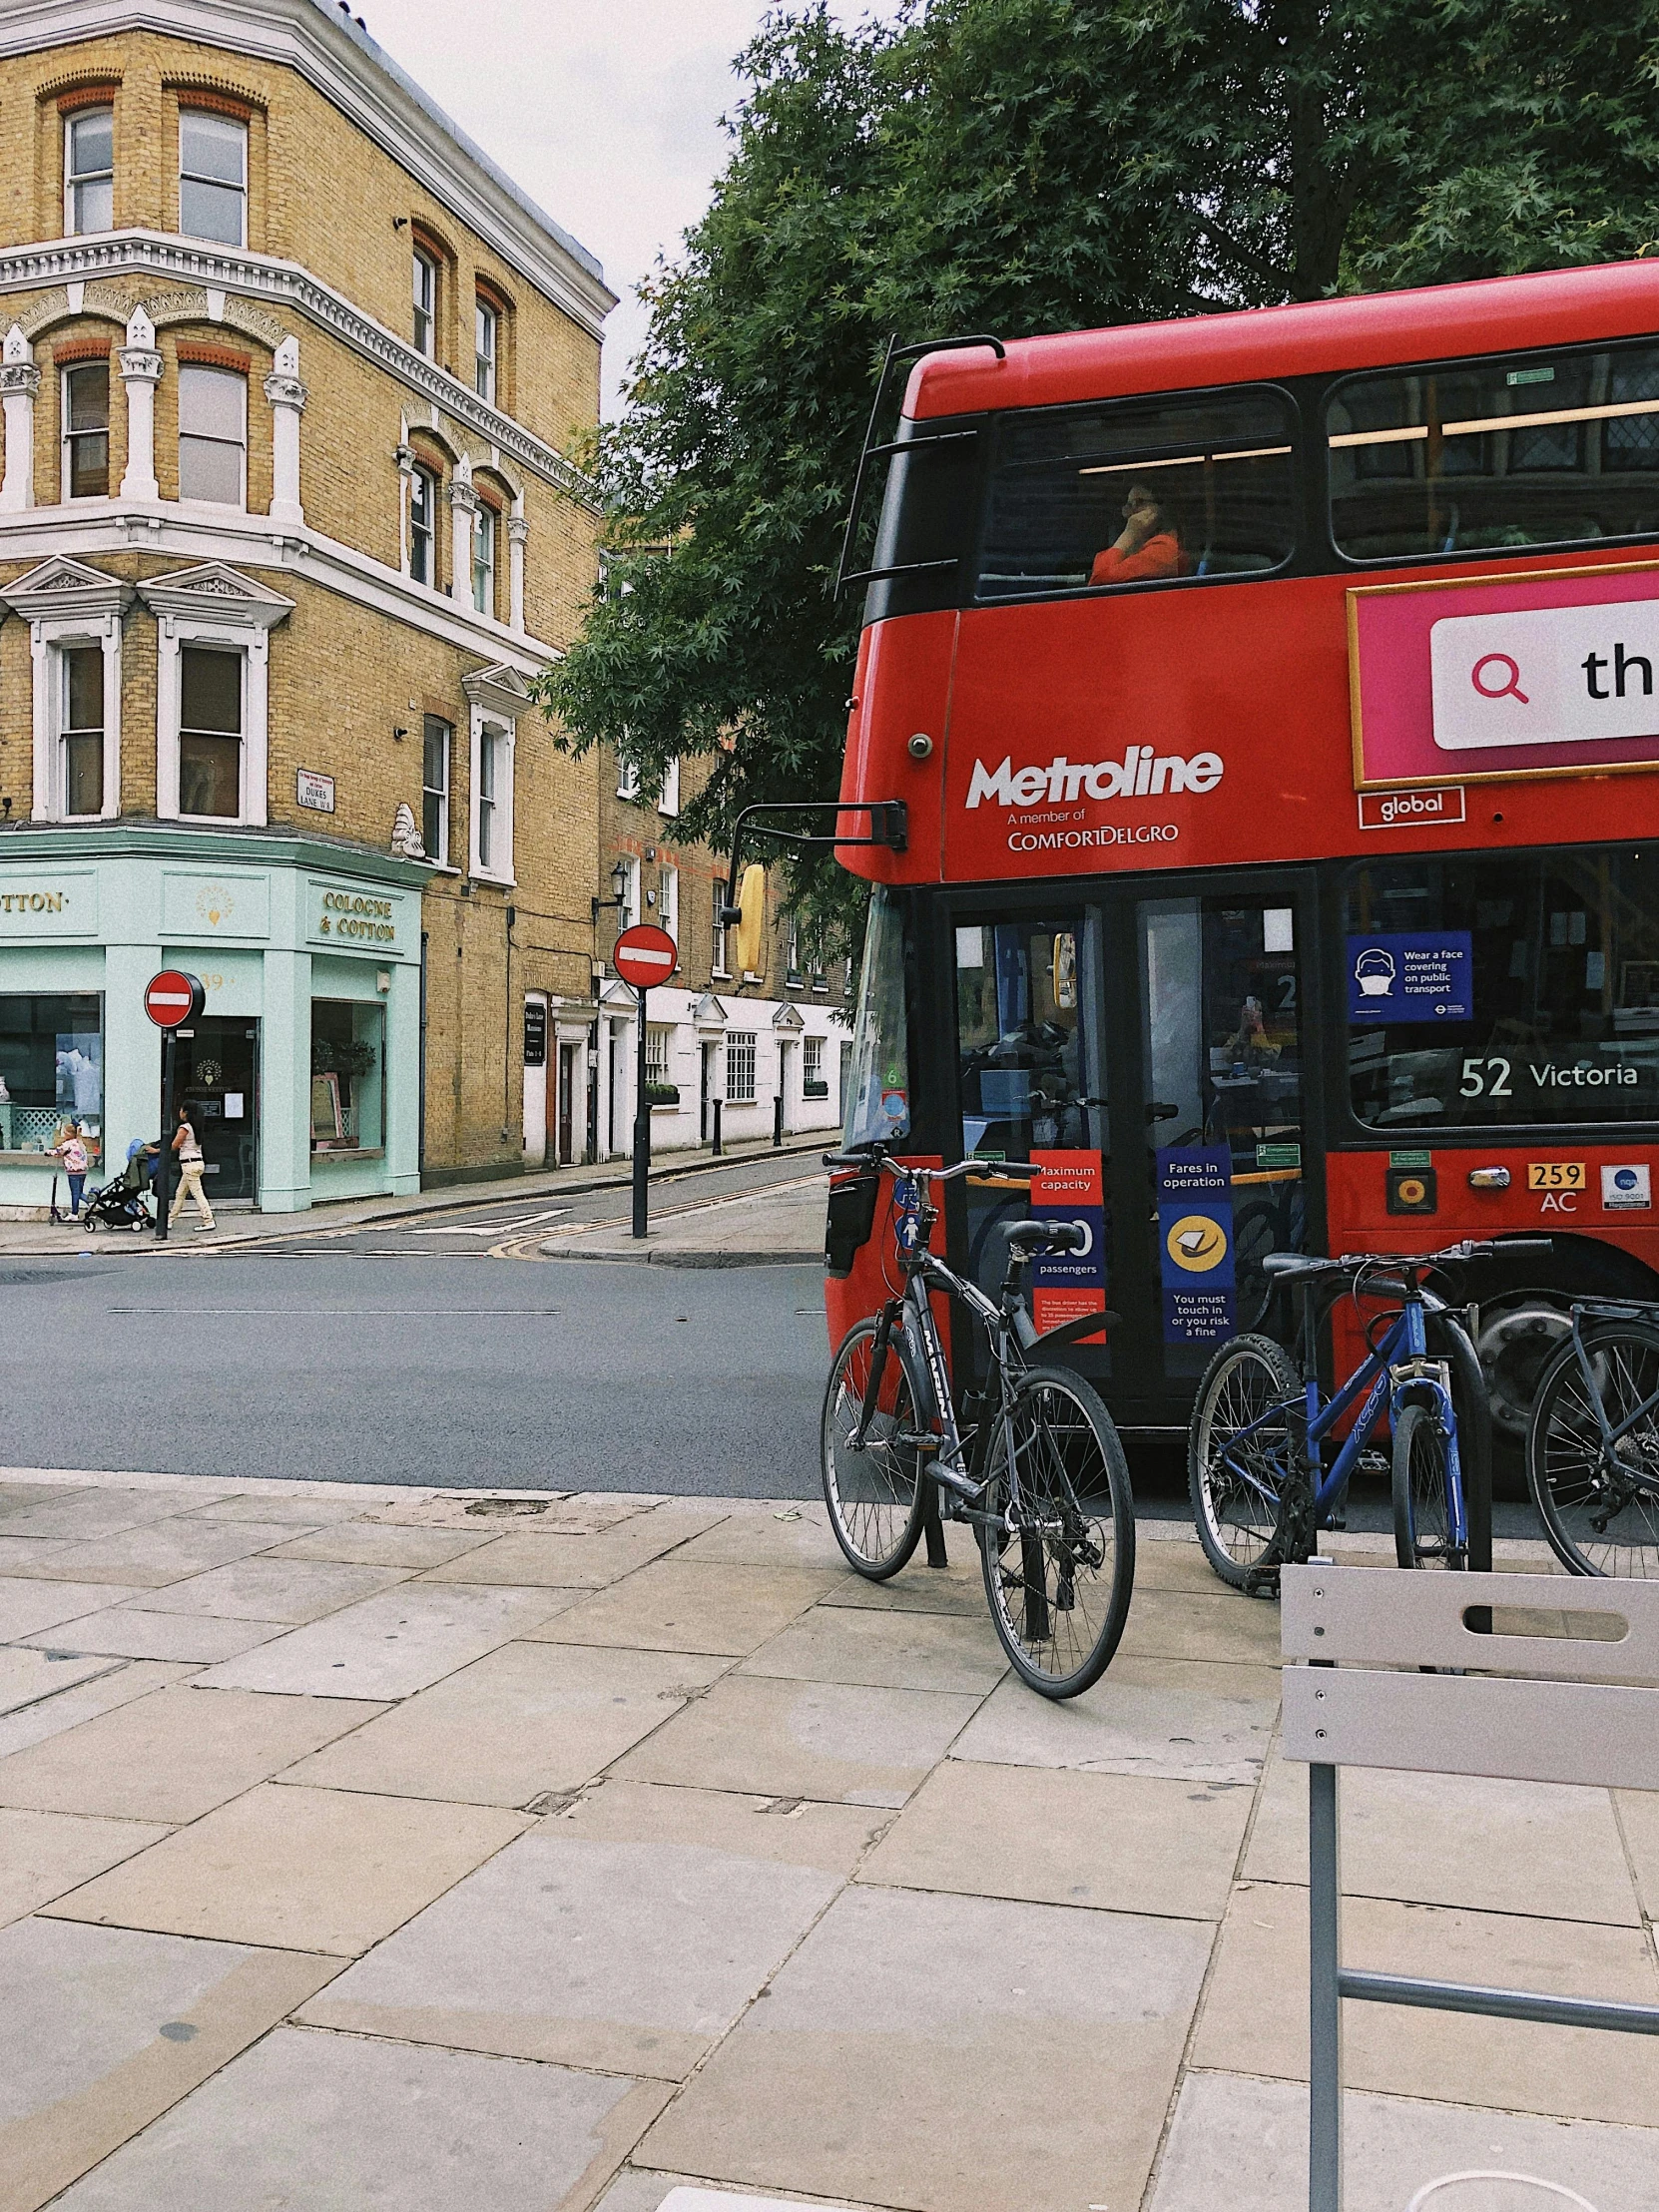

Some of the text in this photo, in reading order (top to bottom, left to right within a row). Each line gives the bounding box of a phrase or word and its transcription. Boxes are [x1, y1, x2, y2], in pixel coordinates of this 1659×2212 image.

[1581, 643, 1653, 700] th
[965, 746, 1224, 809] Metroline
[305, 787, 326, 799] DUKES
[300, 796, 317, 807] LANE
[1381, 794, 1443, 822] global
[1007, 809, 1086, 826] A member of
[0, 892, 63, 912] TTON
[323, 892, 392, 918] COLOGNE
[337, 918, 395, 940] COTTON
[1403, 951, 1430, 960] Wear
[1441, 950, 1463, 959] face
[1404, 962, 1447, 972] covering
[1419, 973, 1451, 984] public
[1404, 984, 1451, 995] transport
[888, 1070, 897, 1084] 6
[1459, 1057, 1638, 1098] 52 Victoria
[1169, 1163, 1218, 1174] Fares in
[1533, 1165, 1580, 1186] 259
[1041, 1180, 1091, 1191] capacity
[1164, 1177, 1225, 1190] operation
[1540, 1192, 1577, 1212] AC
[1040, 1265, 1097, 1275] passengers
[1174, 1295, 1226, 1304] You must
[1178, 1306, 1223, 1315] touch in
[1187, 1318, 1207, 1327] you
[1210, 1317, 1230, 1326] risk
[1195, 1328, 1217, 1337] fine
[923, 1330, 948, 1419] MARIN
